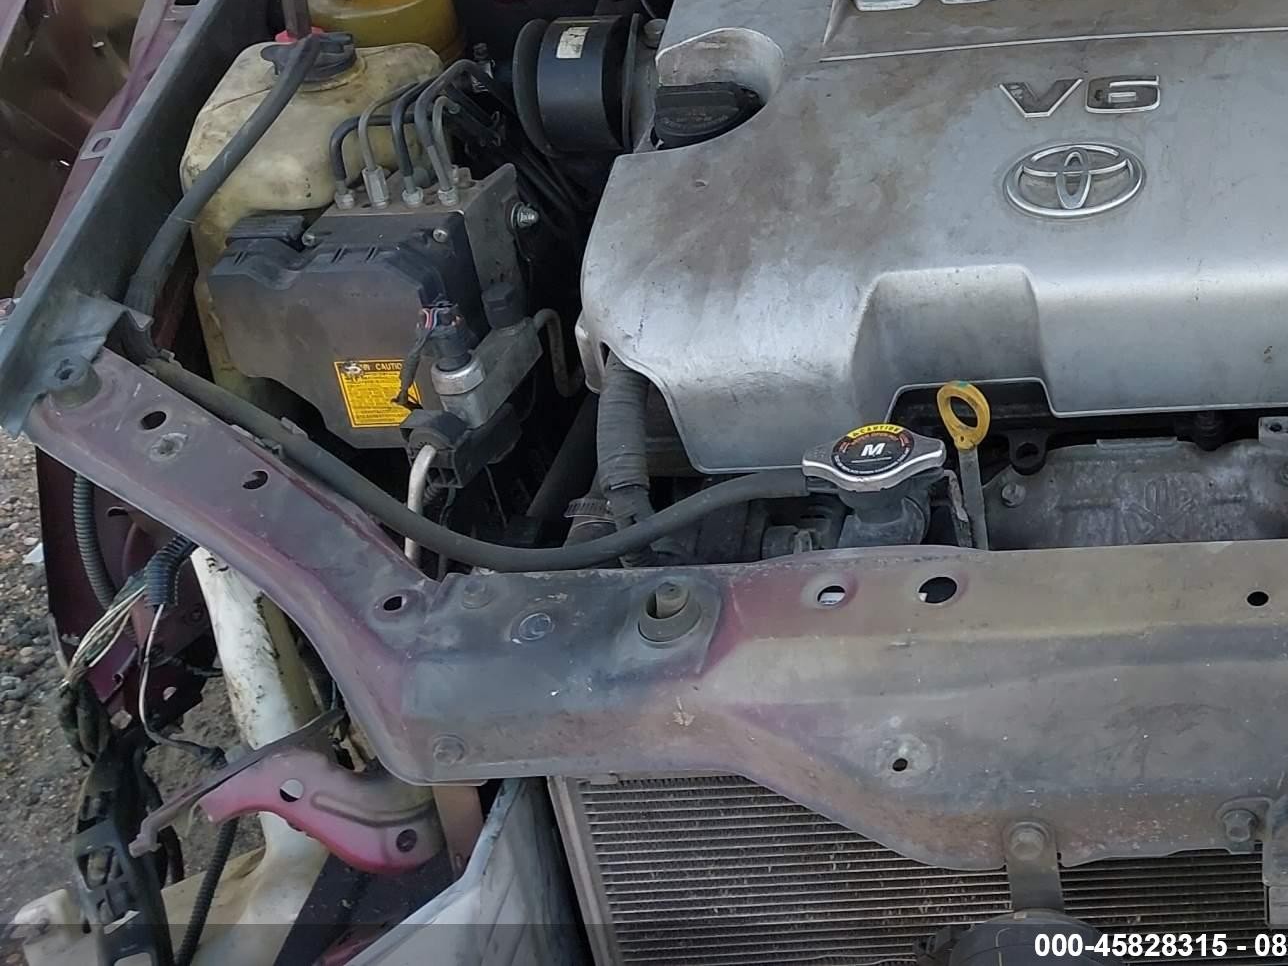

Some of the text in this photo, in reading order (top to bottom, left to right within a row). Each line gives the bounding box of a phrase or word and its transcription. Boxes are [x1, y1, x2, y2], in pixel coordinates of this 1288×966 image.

[1000, 75, 1160, 118] V6
[375, 362, 403, 371] CAUTIO
[861, 442, 886, 457] M
